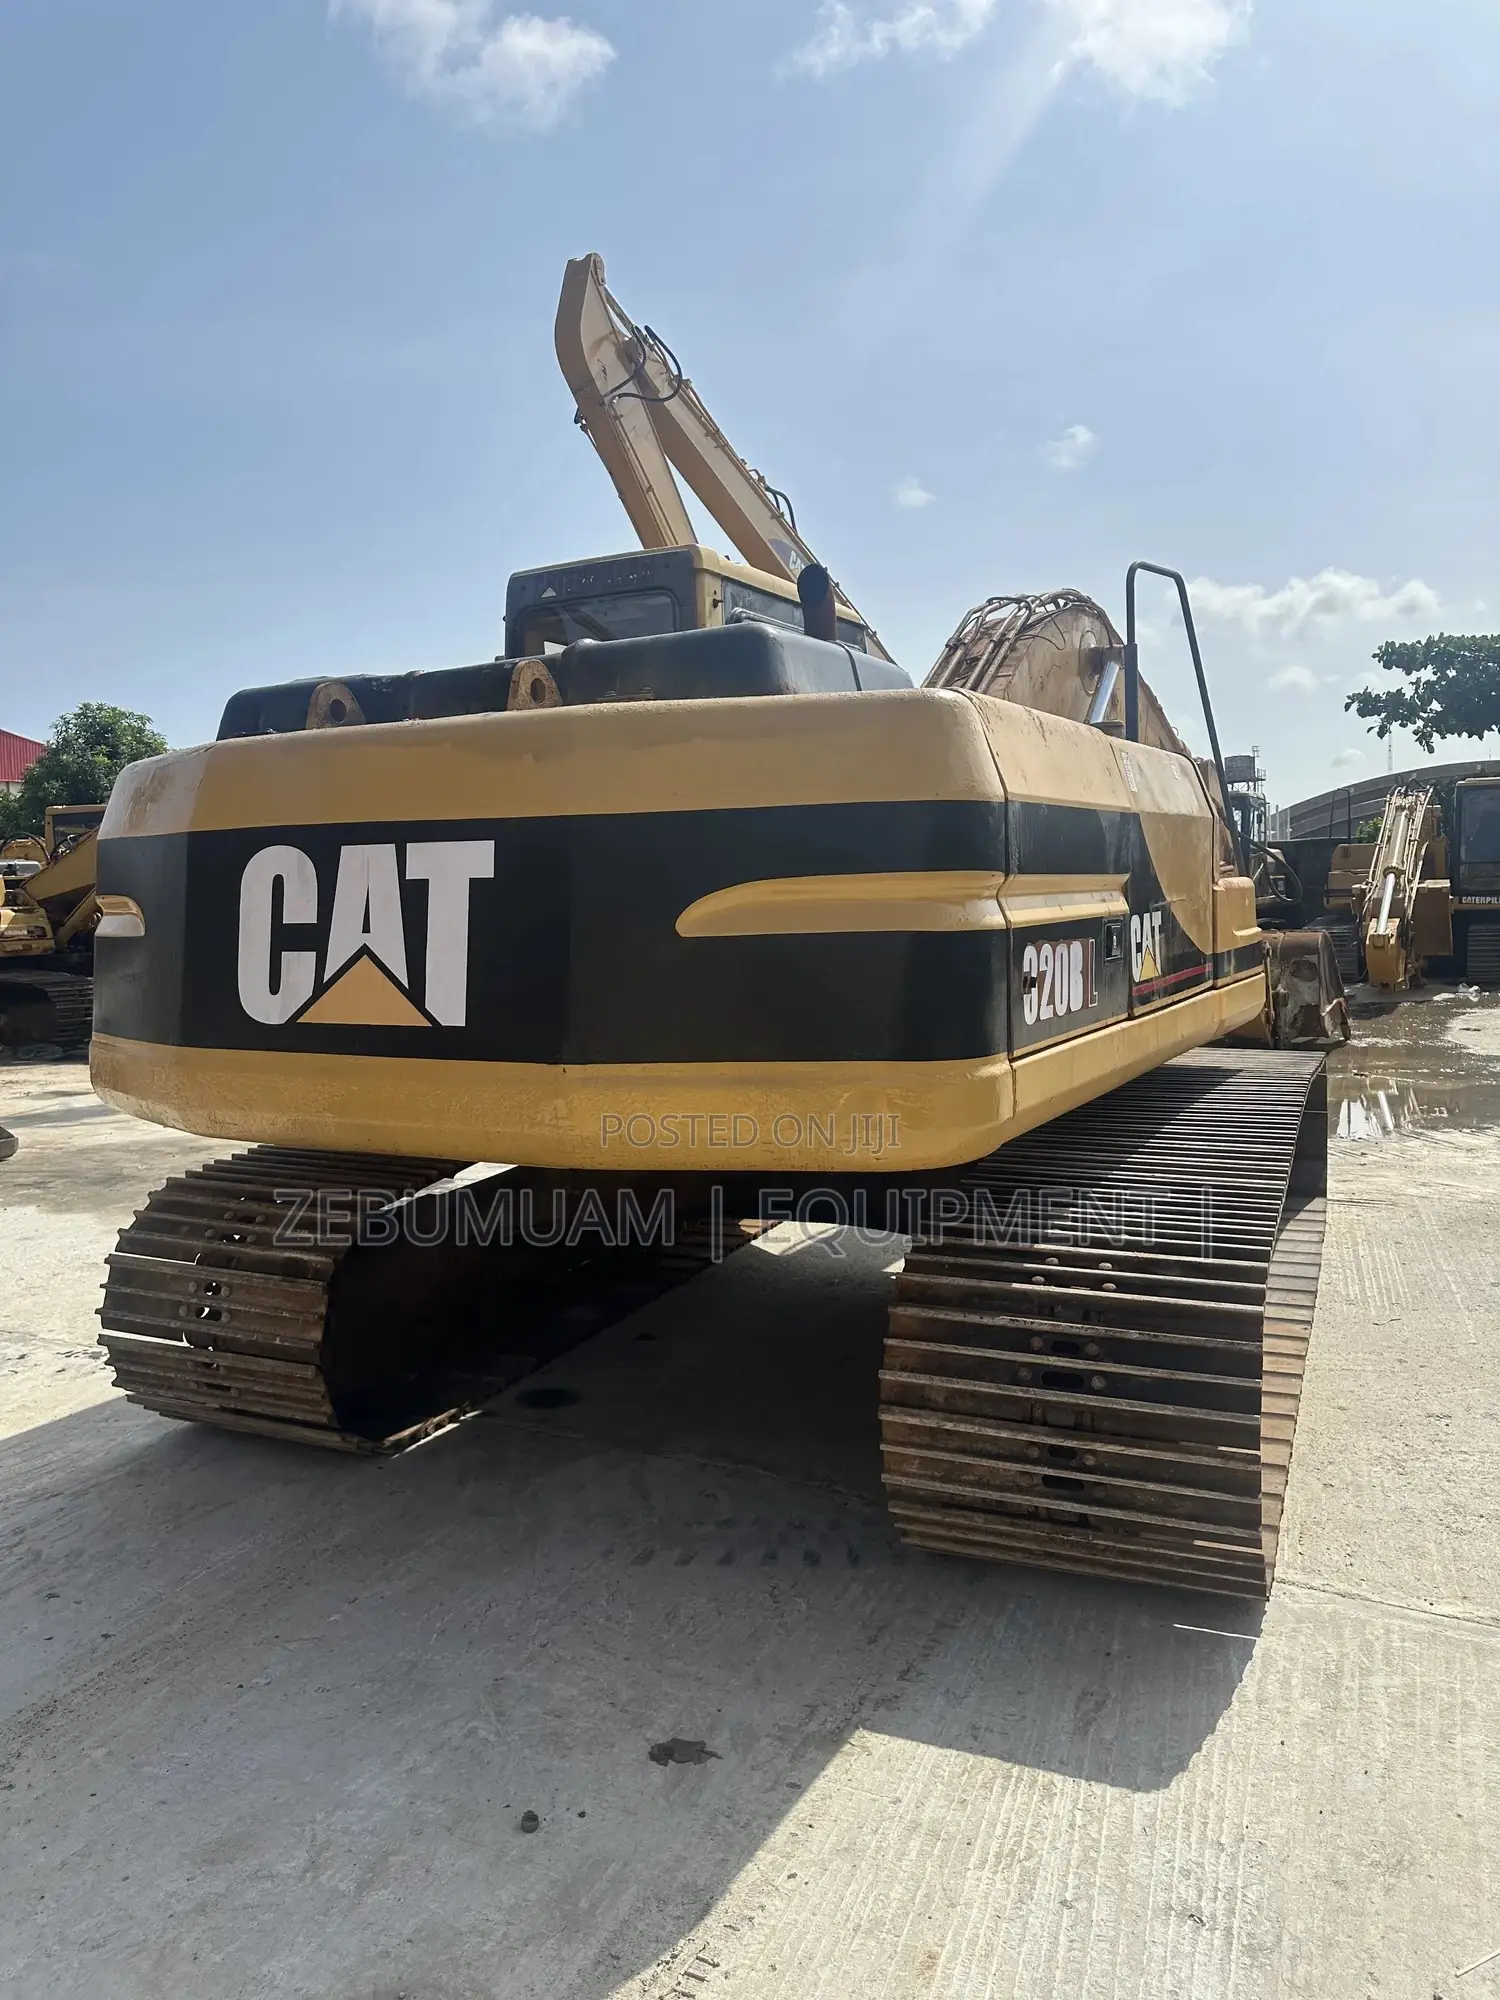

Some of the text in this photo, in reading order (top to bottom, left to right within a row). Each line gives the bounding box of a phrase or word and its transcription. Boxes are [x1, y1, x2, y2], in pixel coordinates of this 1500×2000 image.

[789, 550, 805, 579] CA
[1462, 896, 1500, 904] CATERPIL
[238, 840, 495, 1027] CAT
[1130, 911, 1162, 983] CAT
